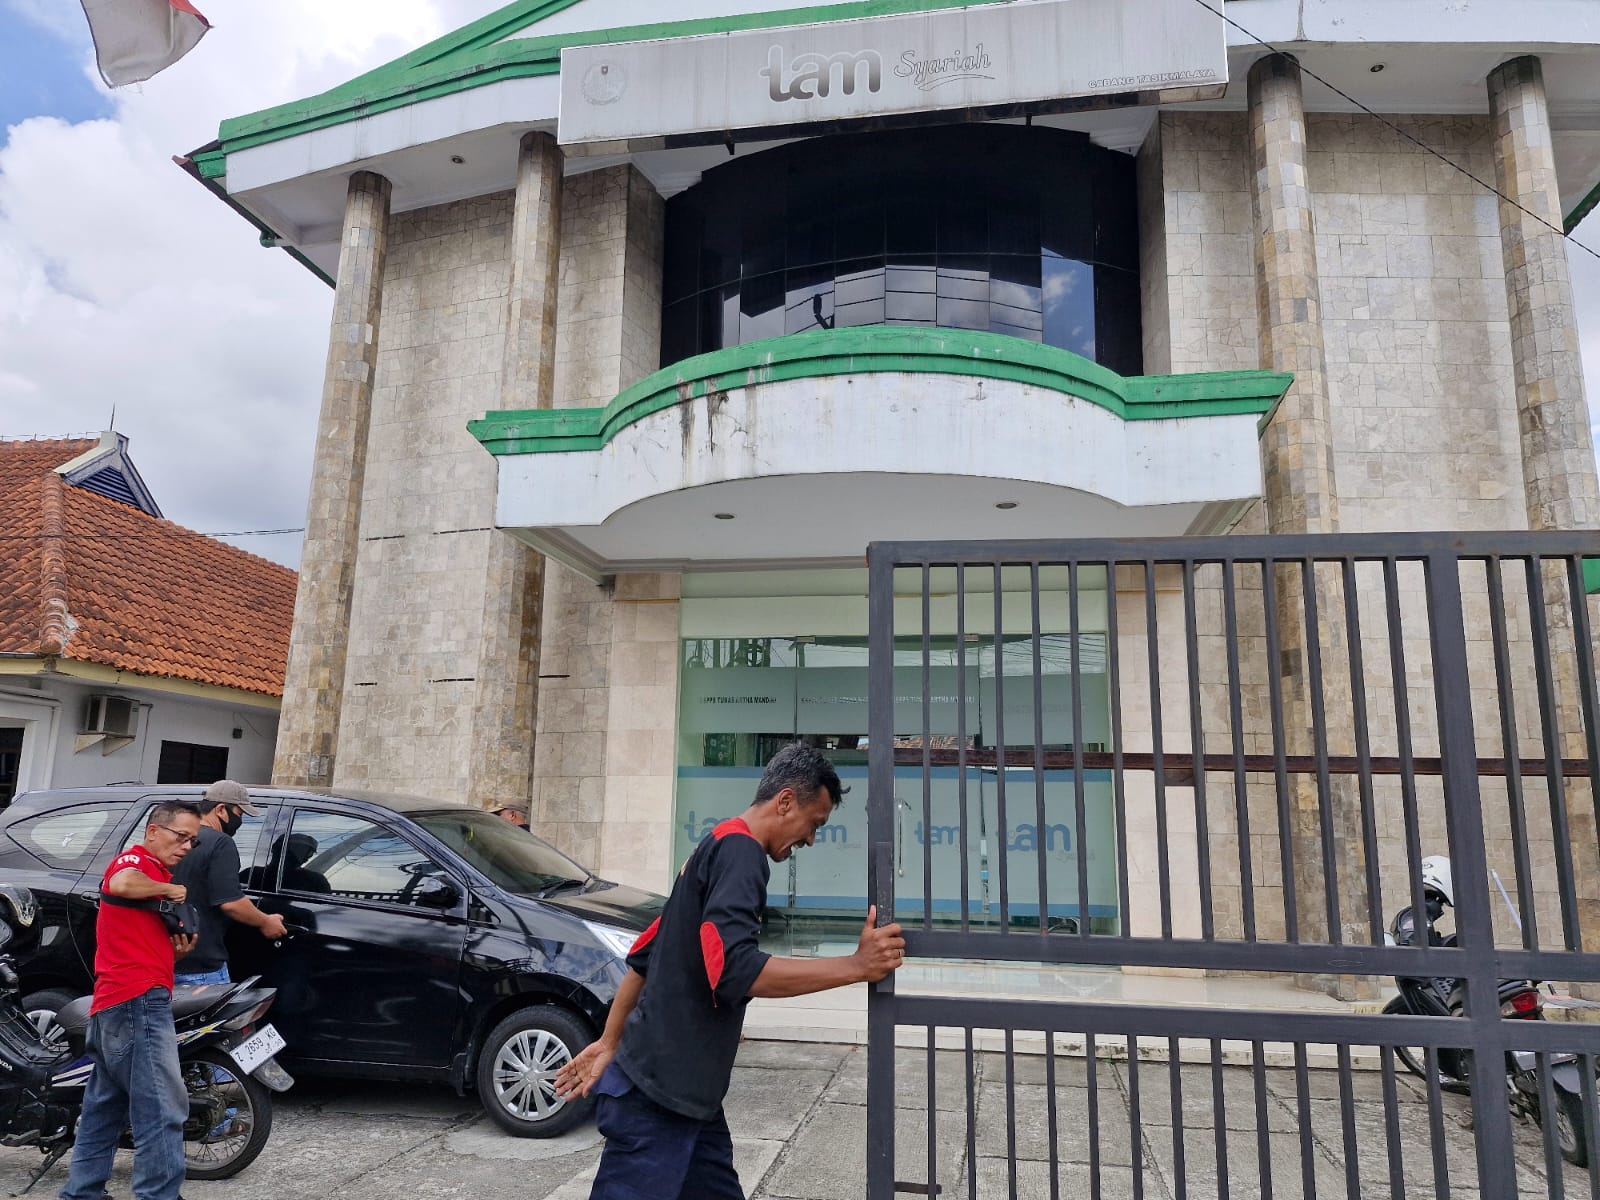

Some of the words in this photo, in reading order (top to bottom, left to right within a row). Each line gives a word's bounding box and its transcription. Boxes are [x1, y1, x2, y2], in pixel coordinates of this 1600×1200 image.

[759, 45, 881, 102] tam
[894, 43, 991, 85] Syariah
[1088, 77, 1134, 88] CABANG
[1137, 69, 1216, 84] TASIKMALAYA
[684, 811, 731, 843] ta
[815, 824, 848, 843] am
